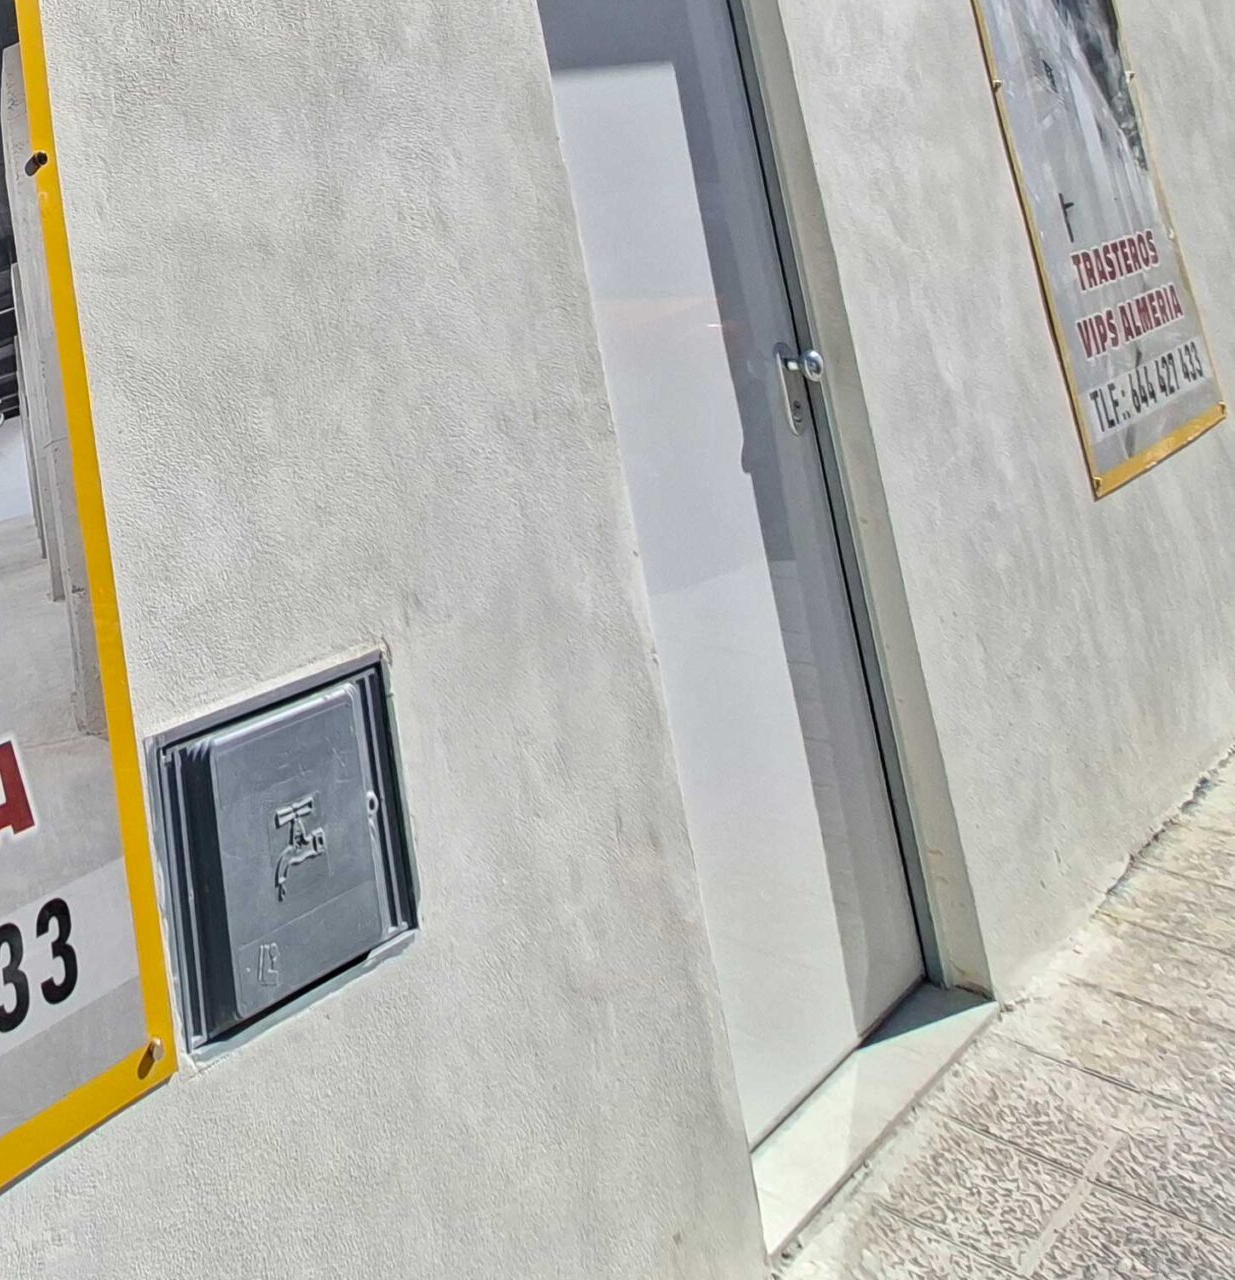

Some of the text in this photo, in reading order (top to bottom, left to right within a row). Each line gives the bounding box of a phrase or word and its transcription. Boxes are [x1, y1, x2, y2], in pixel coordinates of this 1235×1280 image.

[1070, 230, 1159, 291] TRASTEROS
[1076, 284, 1184, 359] VIPS ALMERIA
[1128, 366, 1158, 414] 644
[1154, 351, 1181, 398] 427
[1177, 340, 1204, 383] 433
